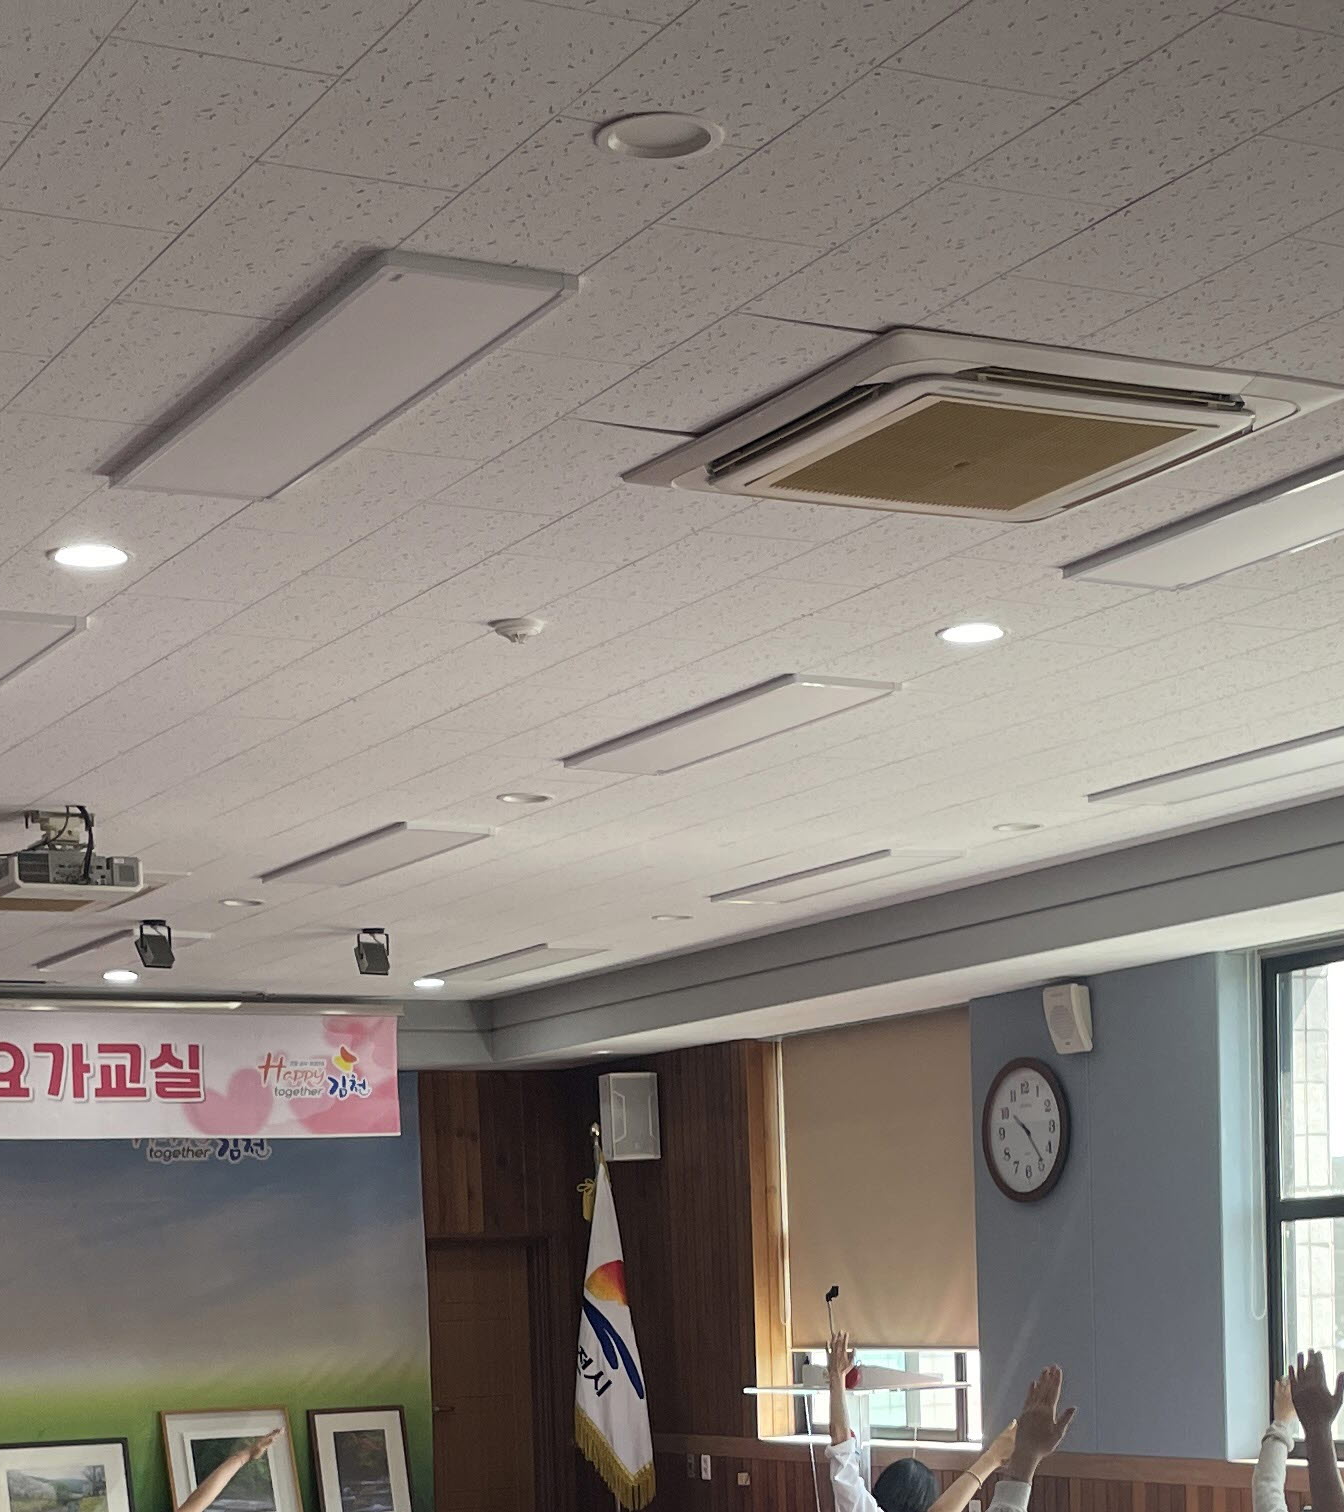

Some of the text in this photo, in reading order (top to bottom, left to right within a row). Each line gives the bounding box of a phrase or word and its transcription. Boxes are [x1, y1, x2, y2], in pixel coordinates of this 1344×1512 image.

[274, 1086, 323, 1098] together
[327, 1074, 371, 1098] 김천
[1020, 1080, 1030, 1094] 12
[1001, 1106, 1010, 1120] 10
[149, 1145, 213, 1161] together
